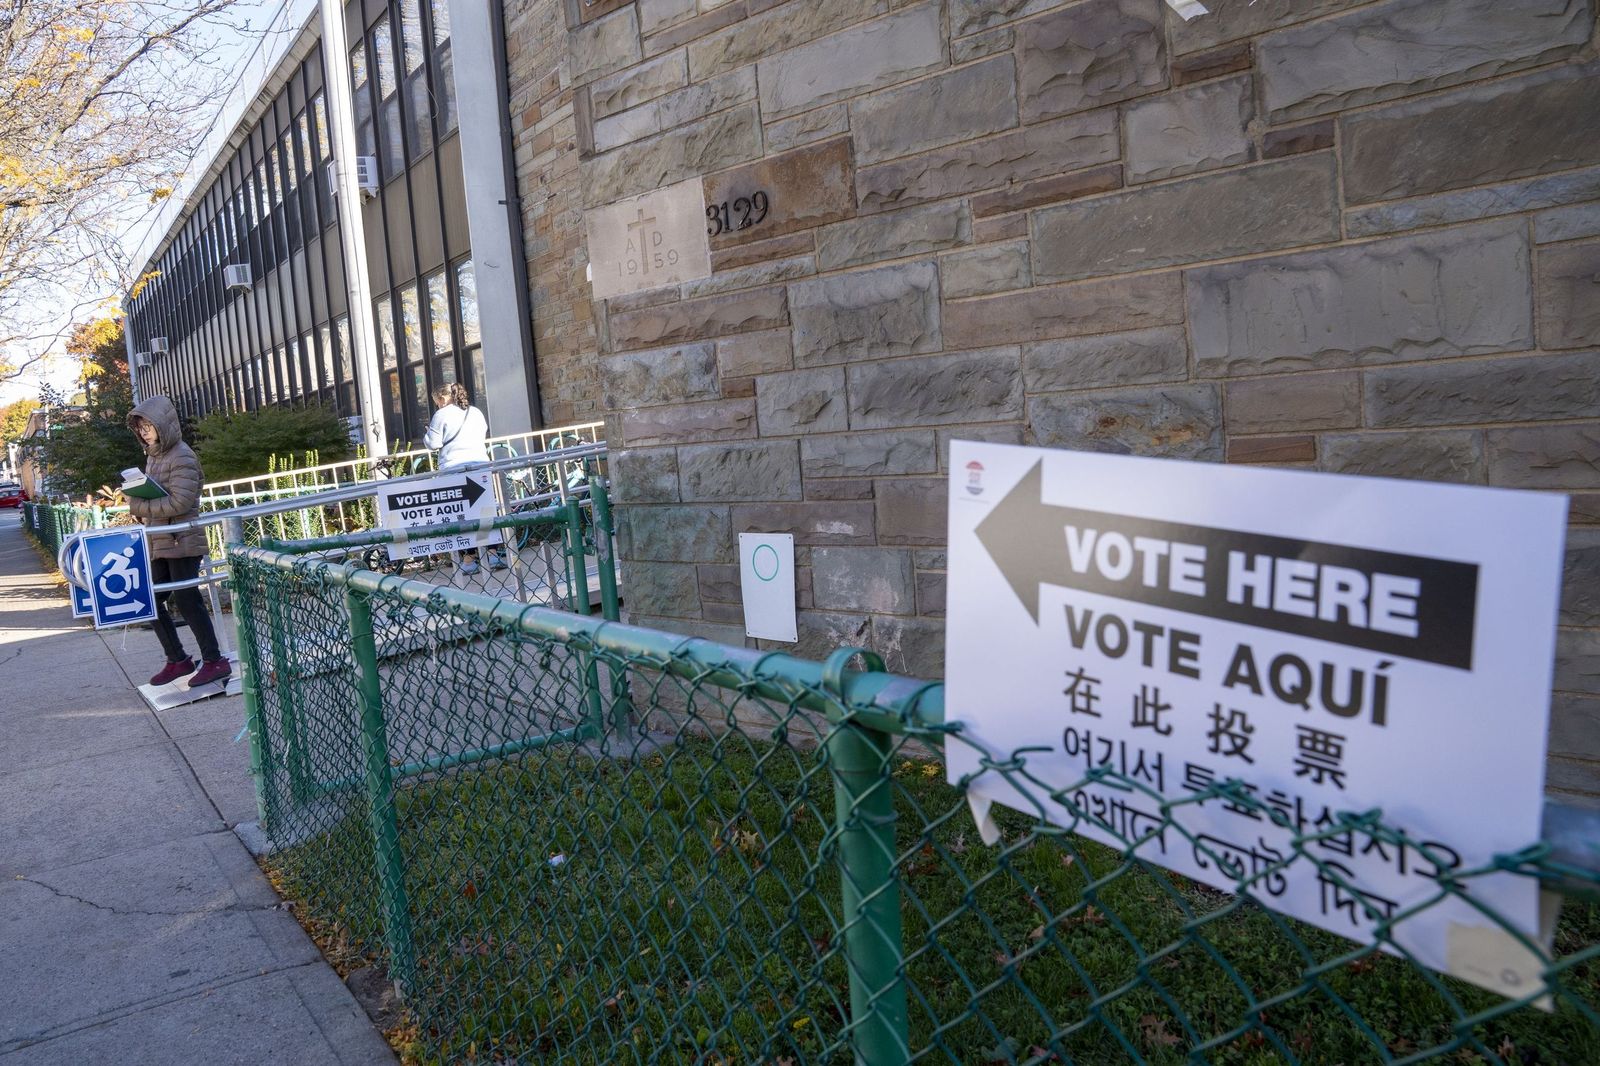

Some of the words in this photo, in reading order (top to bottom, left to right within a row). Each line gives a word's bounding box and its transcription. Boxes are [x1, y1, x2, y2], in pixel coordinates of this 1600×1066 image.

[706, 191, 769, 237] 3129
[626, 238, 636, 254] A
[652, 231, 663, 247] D
[396, 493, 429, 507] VOTE
[431, 489, 463, 502] HERE
[401, 508, 433, 520] VOTE
[436, 502, 464, 516] AQUÍ
[456, 536, 471, 547] দিন
[1064, 525, 1207, 597] VOTE
[1226, 550, 1421, 638] HERE
[1064, 604, 1203, 680] VOTE
[1222, 643, 1396, 727] AQUÍ
[1063, 726, 1164, 793] 여기서
